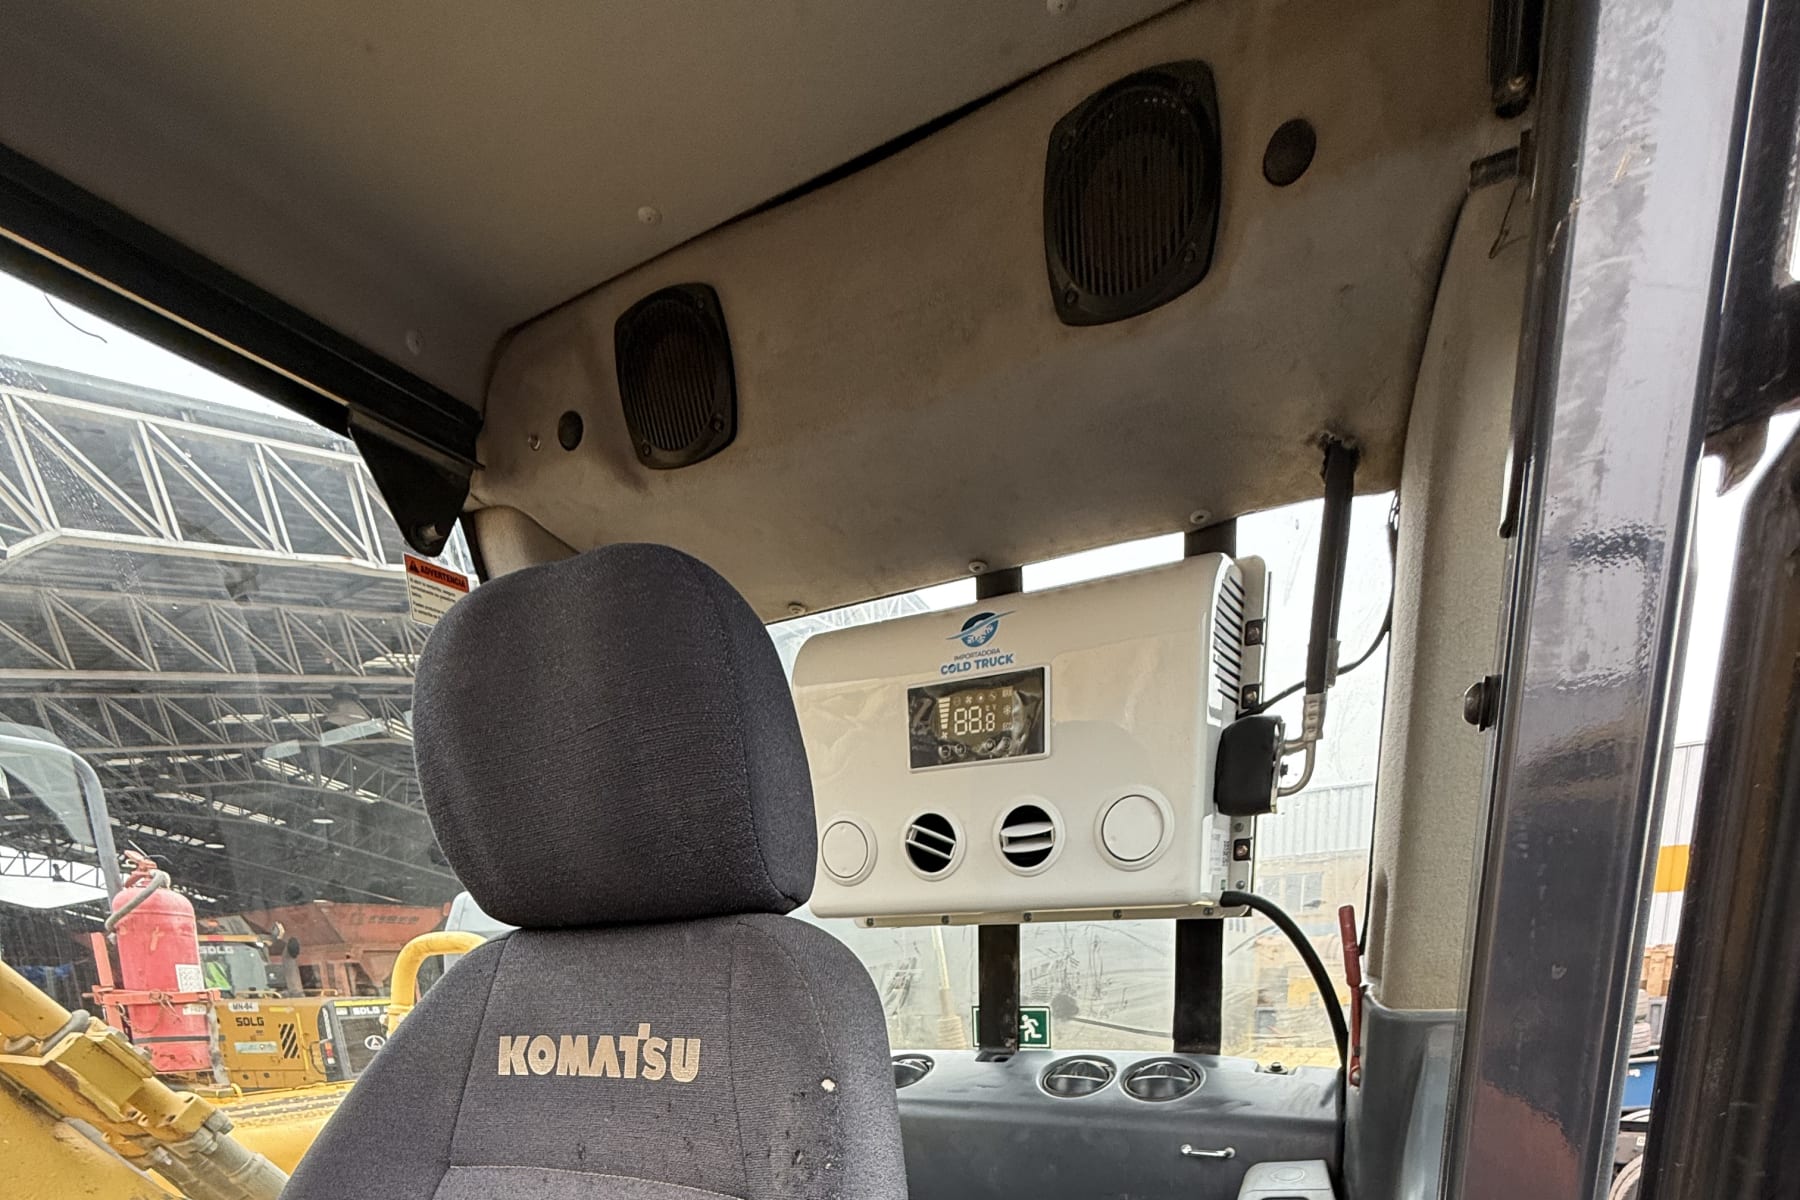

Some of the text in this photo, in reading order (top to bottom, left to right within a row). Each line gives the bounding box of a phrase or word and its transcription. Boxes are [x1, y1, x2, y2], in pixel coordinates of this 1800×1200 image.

[420, 565, 467, 588] ADVERTENCIA
[940, 653, 1014, 675] COLD TRUCK
[954, 647, 1001, 661] IMPORTADORA
[498, 1022, 701, 1083] KOMATSU
